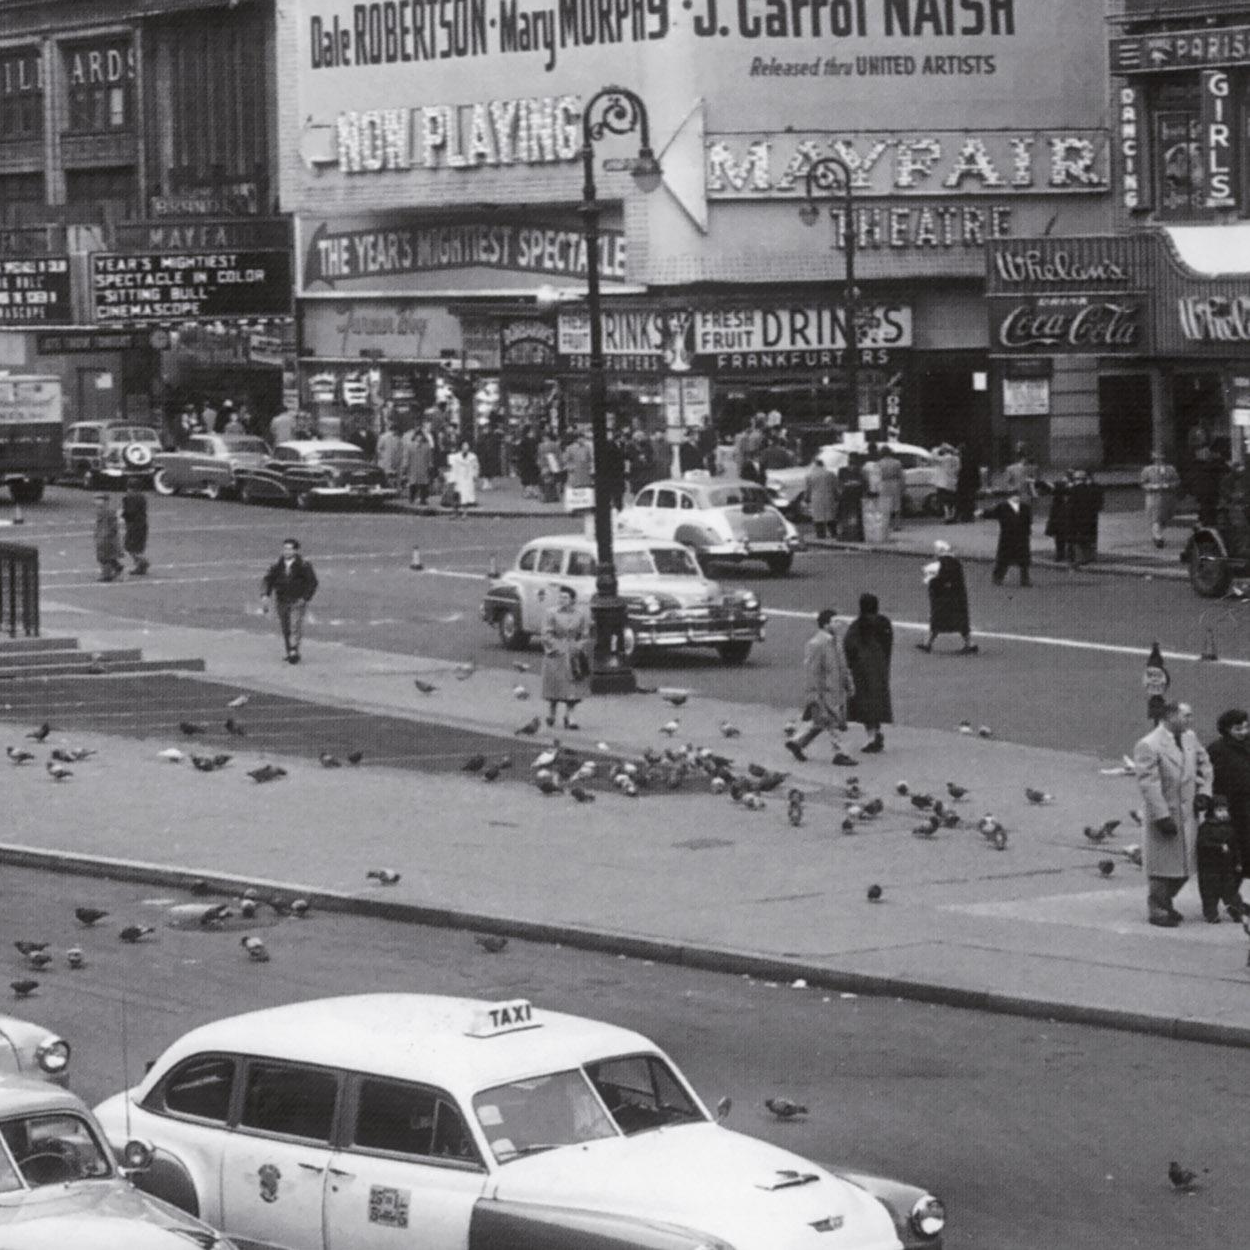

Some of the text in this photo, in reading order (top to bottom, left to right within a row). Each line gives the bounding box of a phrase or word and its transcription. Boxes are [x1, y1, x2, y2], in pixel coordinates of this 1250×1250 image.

[310, 14, 351, 69] Dale
[750, 54, 997, 77] Released thru UNITED ARTISTS
[338, 96, 583, 173] NOW PLAYING
[1121, 87, 1138, 208] DANCING
[1208, 72, 1231, 199] GIRLS
[708, 137, 1106, 191] MAYFAIR
[830, 206, 1012, 250] THEATRE
[96, 254, 237, 272] YEAR'S MIGHTIEST
[318, 223, 626, 277] THE YEAR'S MIGHTIEST SPECTALE
[996, 250, 1129, 282] Whelan's
[95, 269, 265, 288] SPECTACLE IN COLOR
[97, 301, 200, 319] CINEMASCOPE
[702, 312, 754, 328] FRESH
[605, 313, 664, 350] RINKS
[702, 331, 754, 349] FRUIT
[718, 351, 890, 370] FRANKFURTRS
[488, 1003, 532, 1028] TAXI
